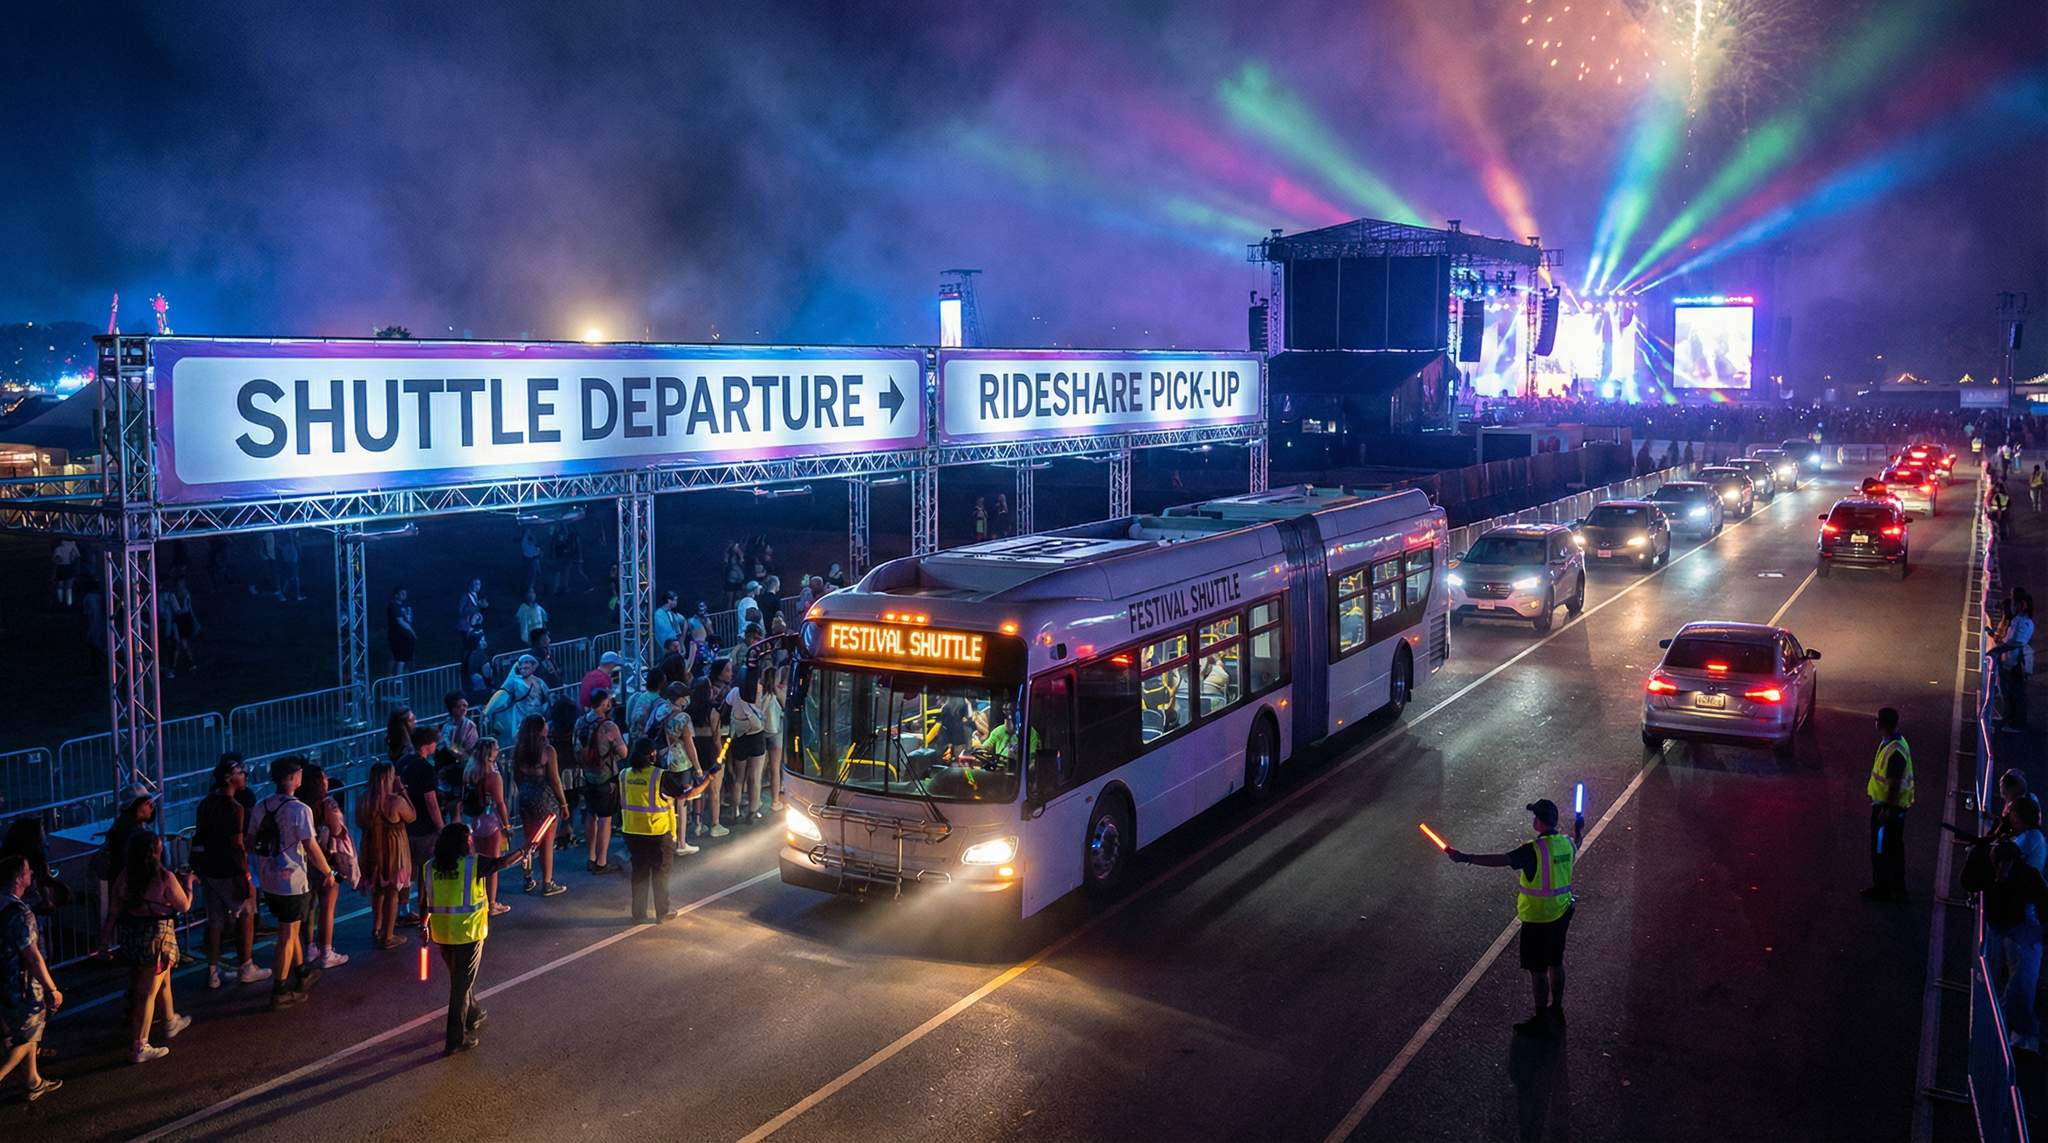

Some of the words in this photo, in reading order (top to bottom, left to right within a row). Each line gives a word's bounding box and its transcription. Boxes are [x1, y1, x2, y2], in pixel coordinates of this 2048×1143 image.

[235, 379, 561, 458] SHUTTLE
[581, 375, 864, 440] DEPARTURE
[980, 372, 1143, 420] RIDESHARE
[1150, 371, 1240, 411] PICK-UP
[1128, 589, 1189, 634] FESTIVAL
[1190, 572, 1241, 613] SHUTTLE
[830, 624, 905, 656] FESTIVAL
[909, 631, 984, 662] SHUTTLE
